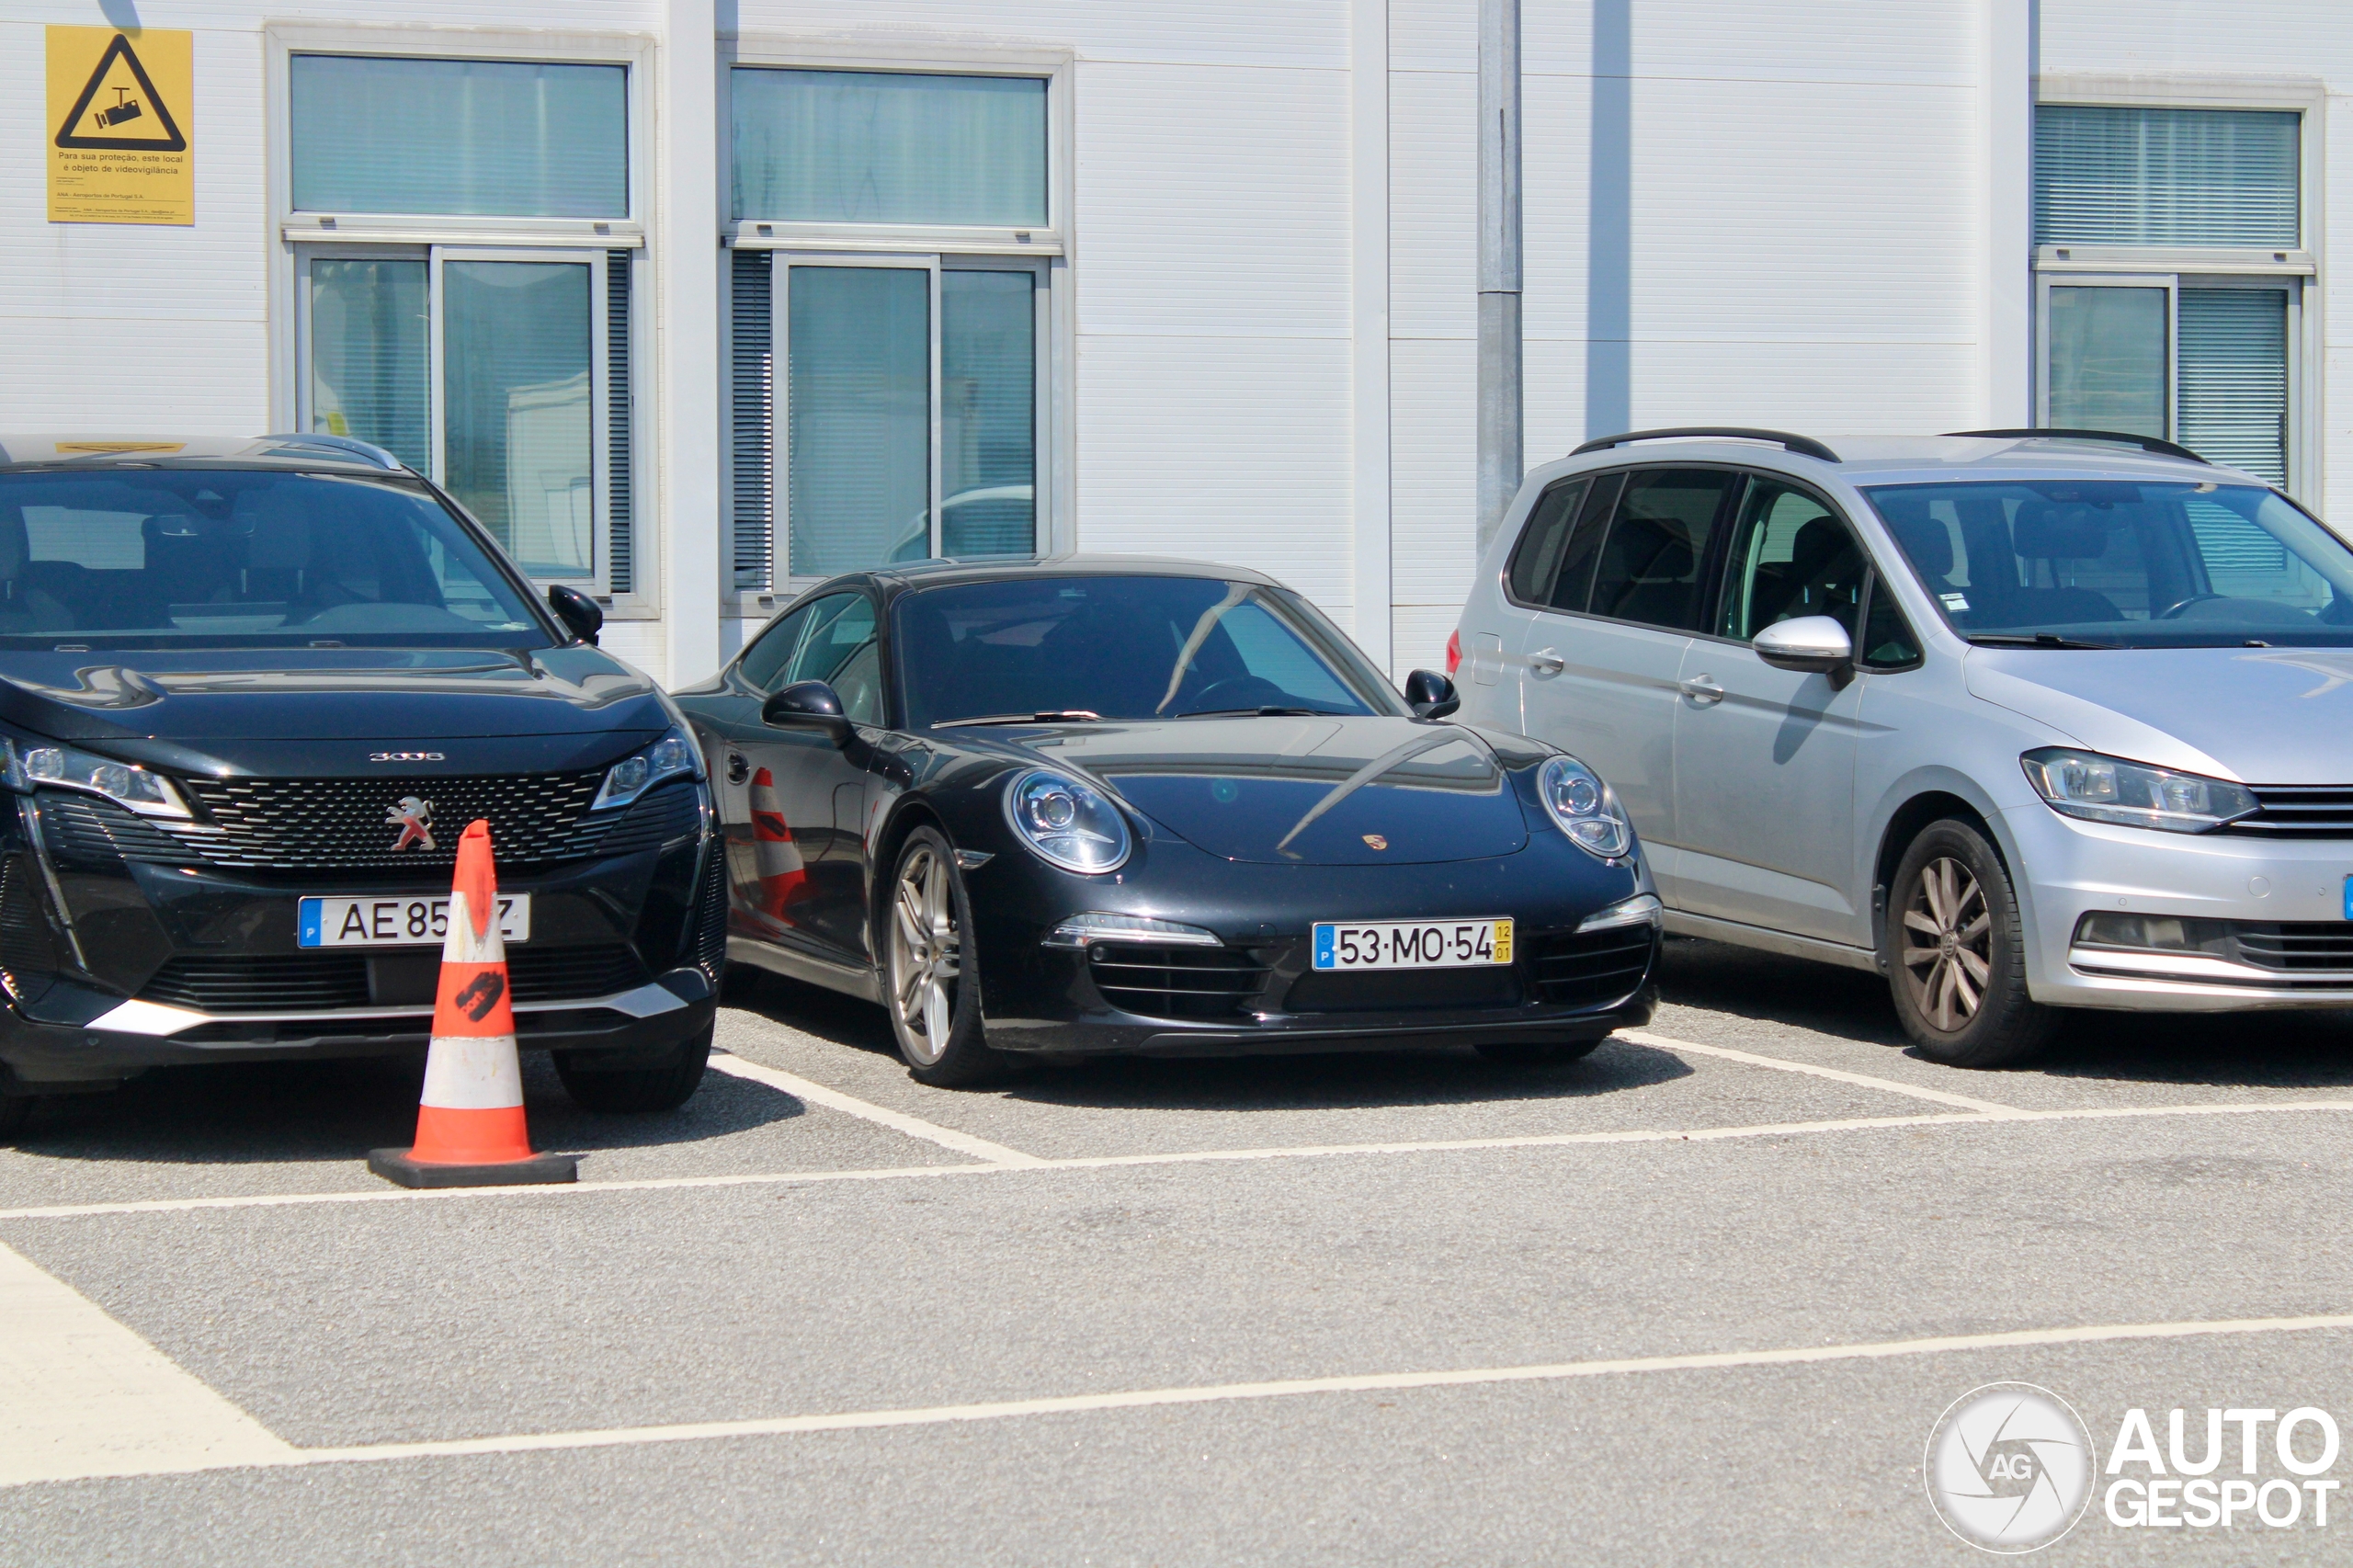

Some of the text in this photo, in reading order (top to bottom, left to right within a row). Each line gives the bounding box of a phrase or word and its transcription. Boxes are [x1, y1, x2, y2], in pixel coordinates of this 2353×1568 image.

[59, 152, 78, 160] Para
[99, 153, 139, 163] proteção,
[72, 165, 98, 173] objeto
[115, 165, 178, 176] videovigilância
[369, 752, 446, 762] 3008
[338, 902, 399, 939] AE
[406, 901, 449, 937] 85
[306, 927, 316, 938] P
[1497, 925, 1510, 937] 12
[1321, 951, 1330, 961] P
[1496, 947, 1509, 959] 01
